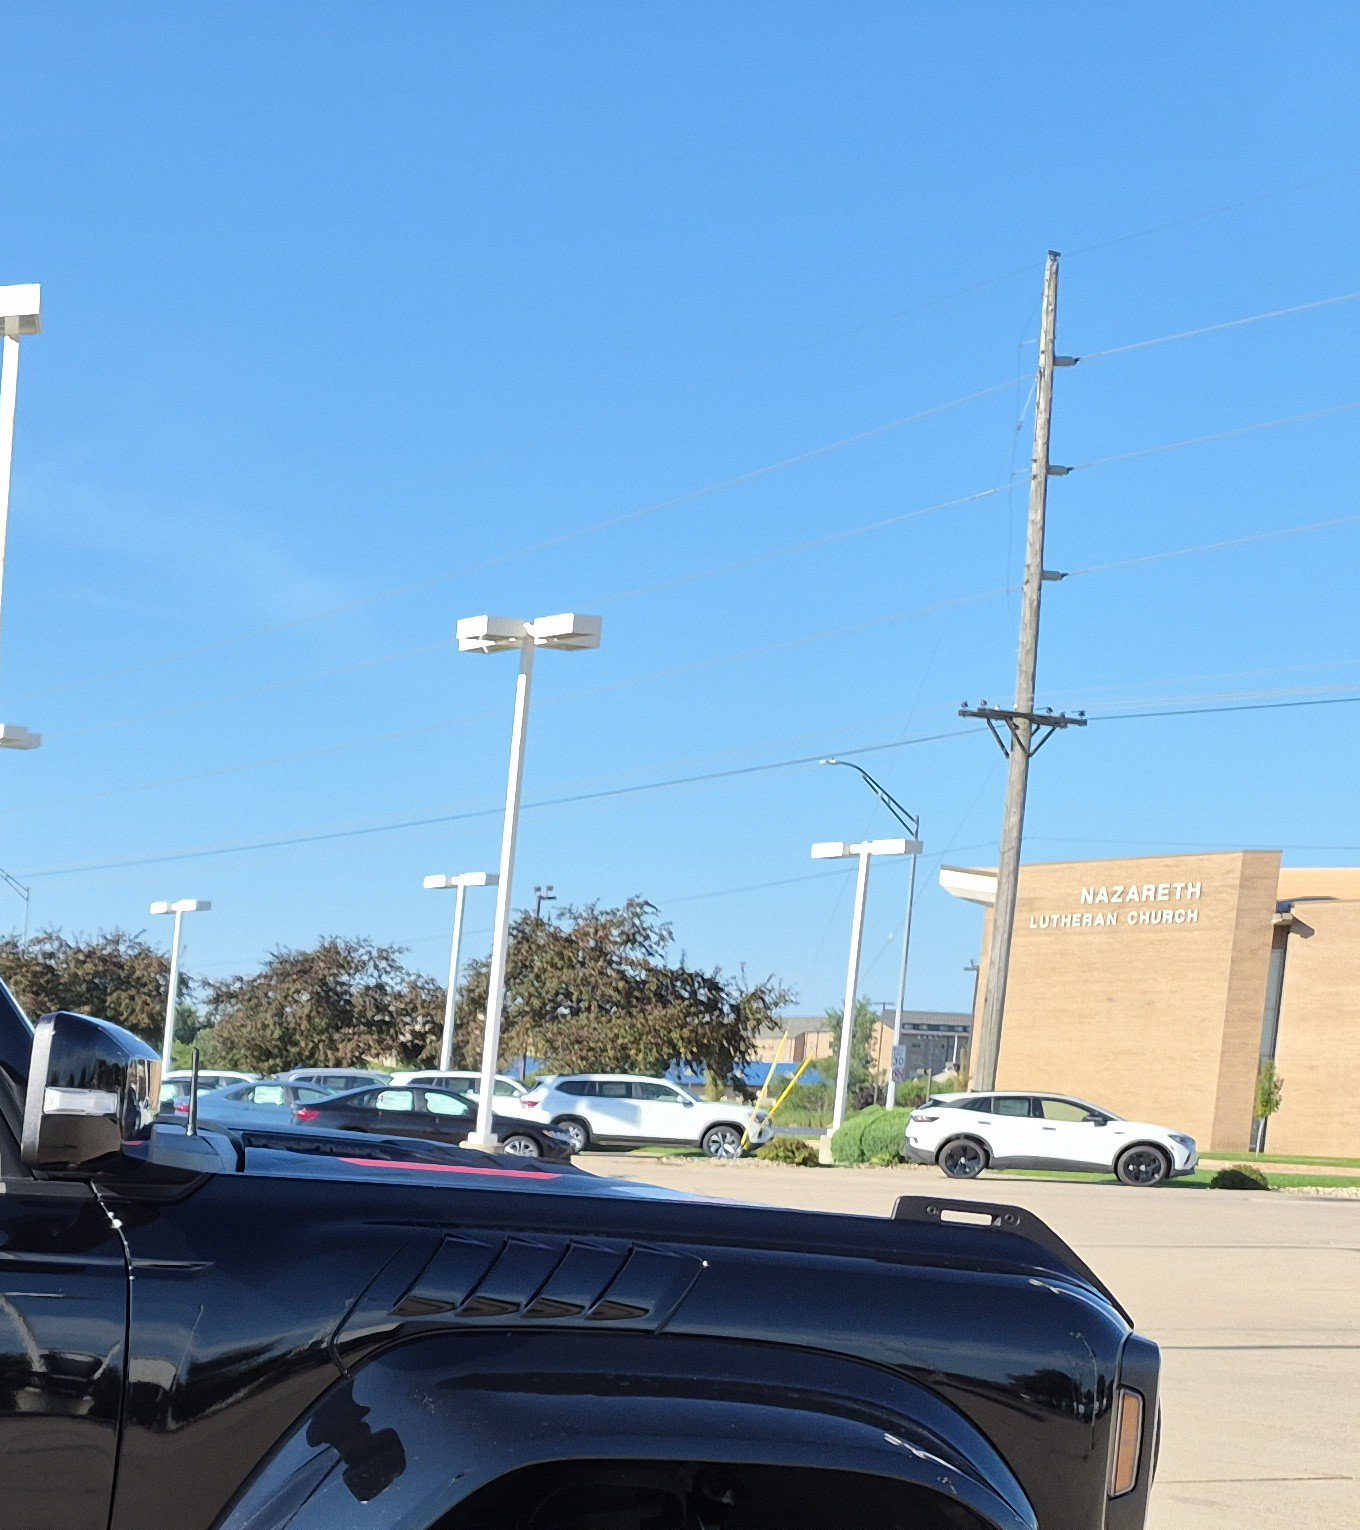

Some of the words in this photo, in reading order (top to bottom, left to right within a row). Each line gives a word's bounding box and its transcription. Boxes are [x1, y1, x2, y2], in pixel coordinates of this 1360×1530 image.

[1080, 881, 1202, 905] NAZARETH
[1029, 911, 1119, 929] LUTHERAN
[1126, 908, 1199, 926] CHURCH
